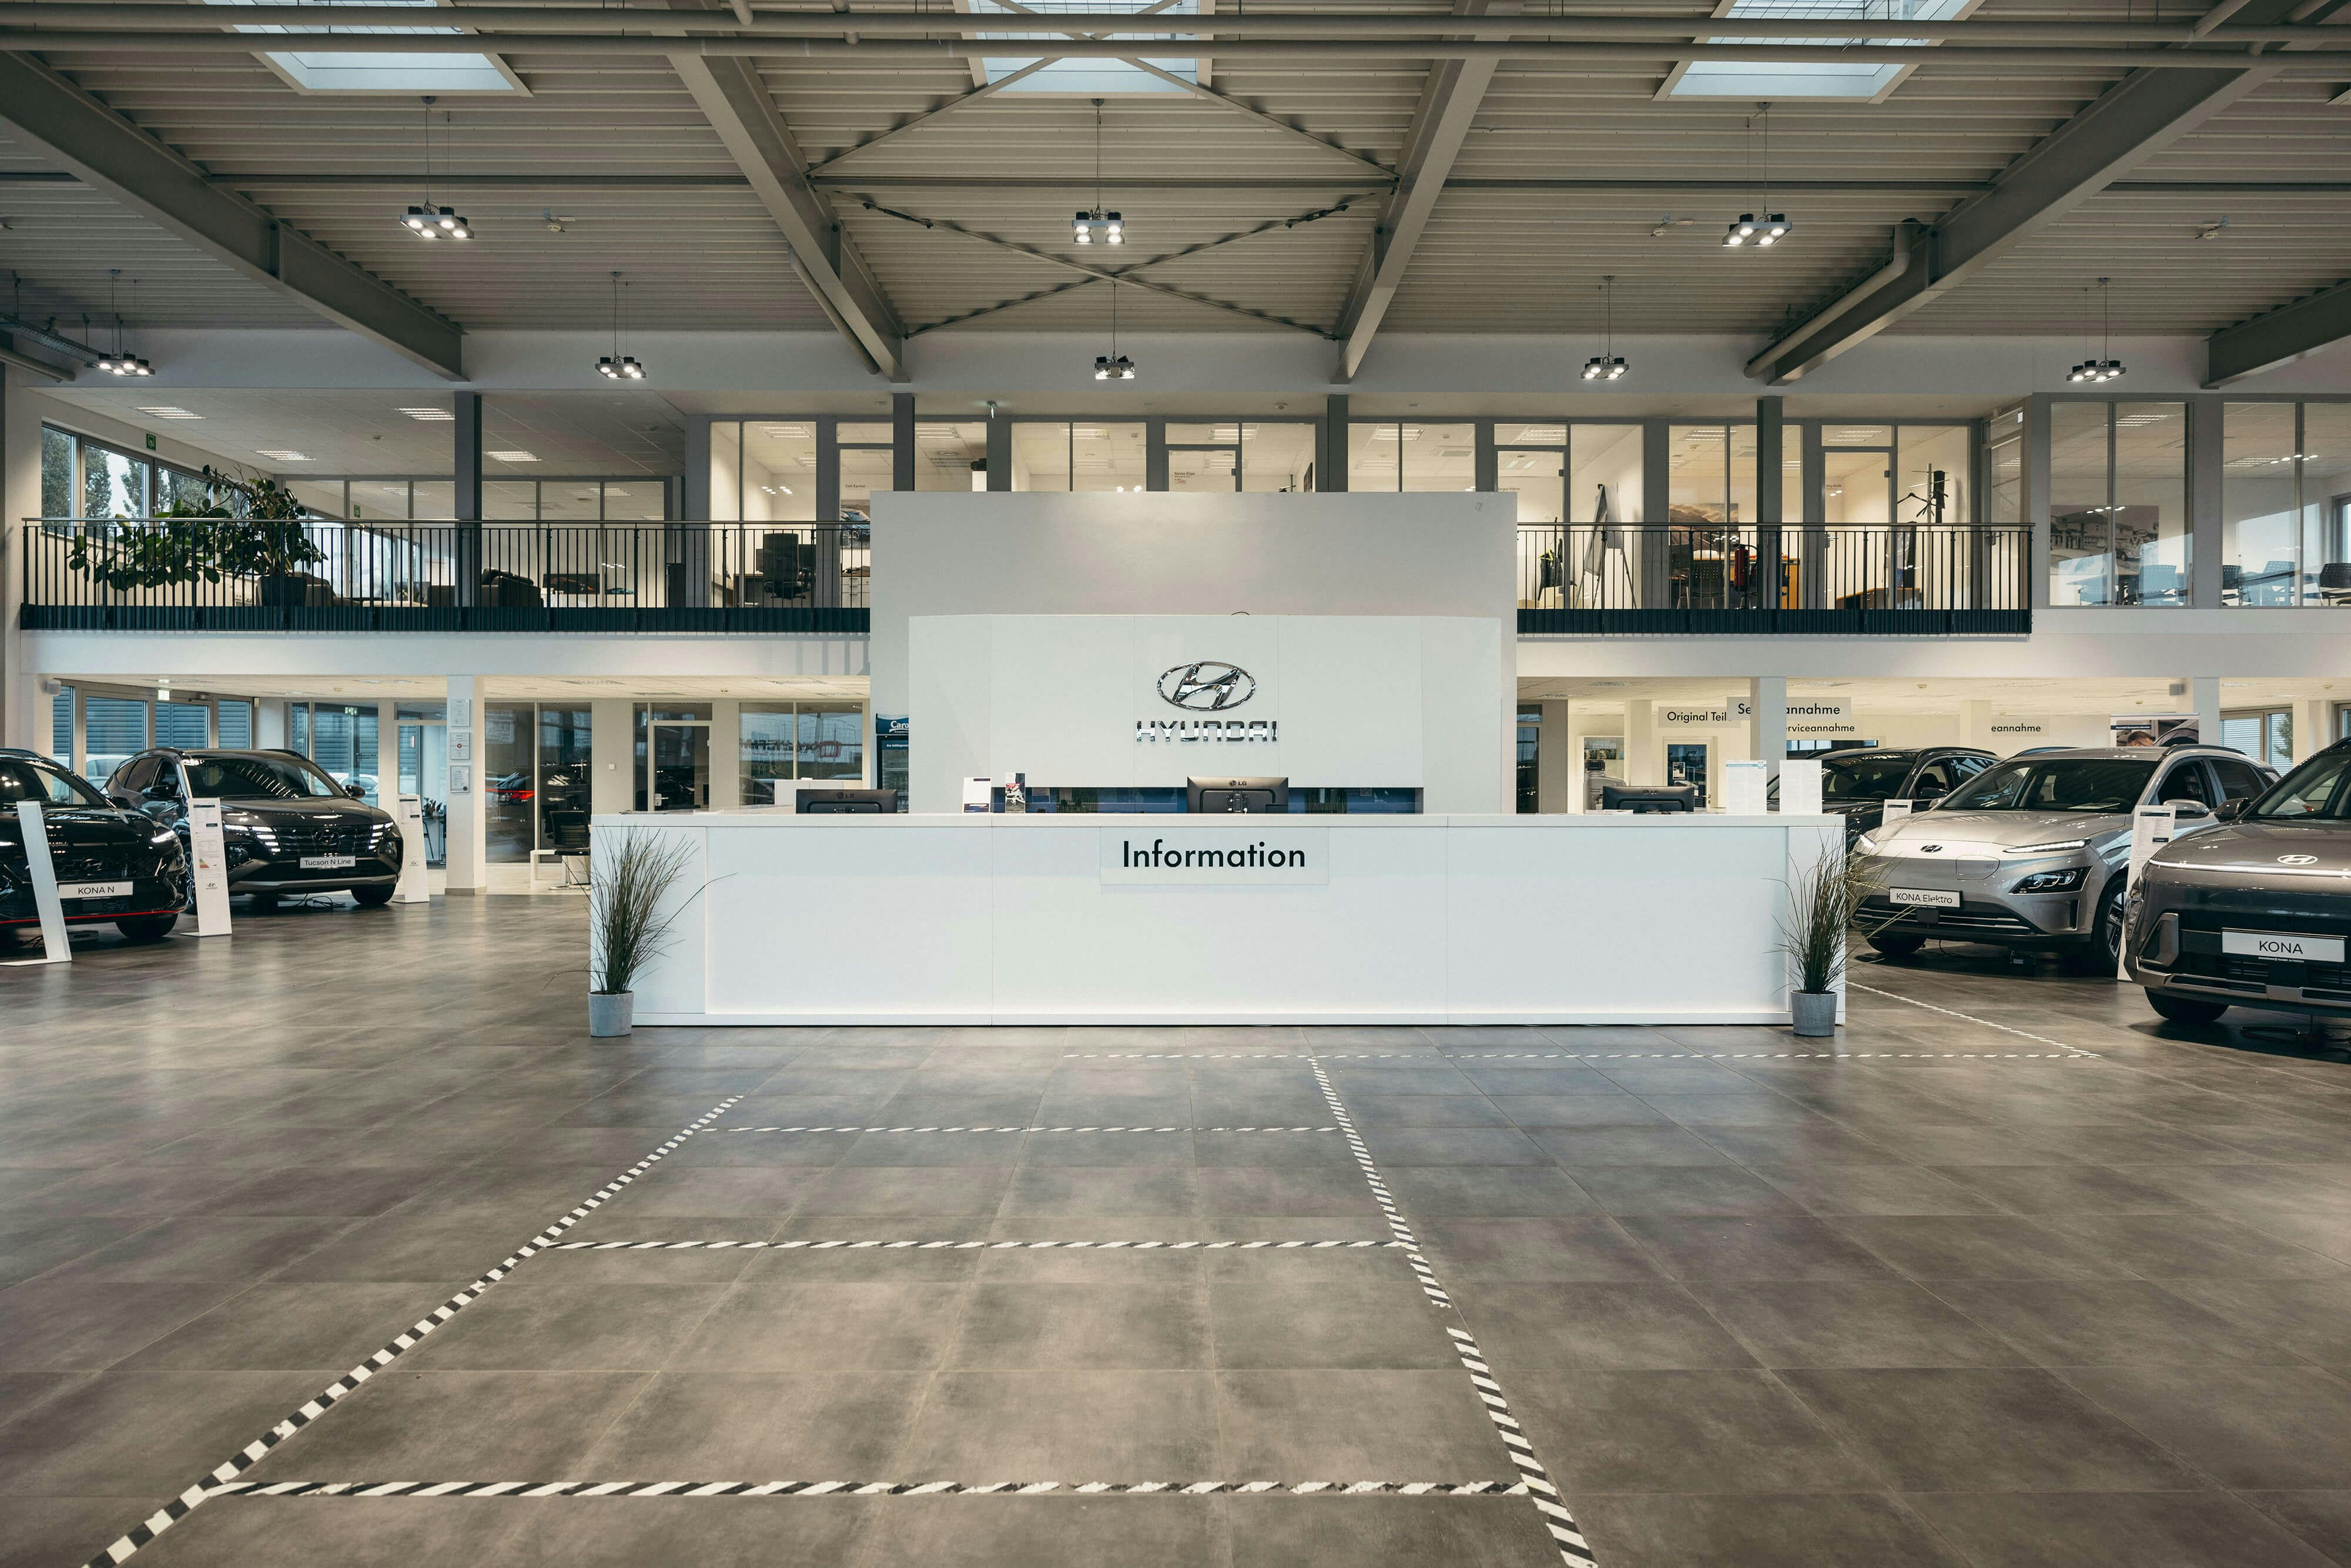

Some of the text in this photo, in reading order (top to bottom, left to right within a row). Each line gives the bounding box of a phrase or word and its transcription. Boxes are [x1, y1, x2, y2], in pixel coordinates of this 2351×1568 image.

[1667, 711, 1727, 723] Original Teil
[1136, 721, 1277, 742] HYUNDAI
[1786, 723, 1856, 732] rviceannahme
[1123, 839, 1305, 867] Information
[78, 886, 106, 894] KONA
[1896, 893, 1953, 904] KONA Elektro
[2259, 940, 2303, 954] KONA
